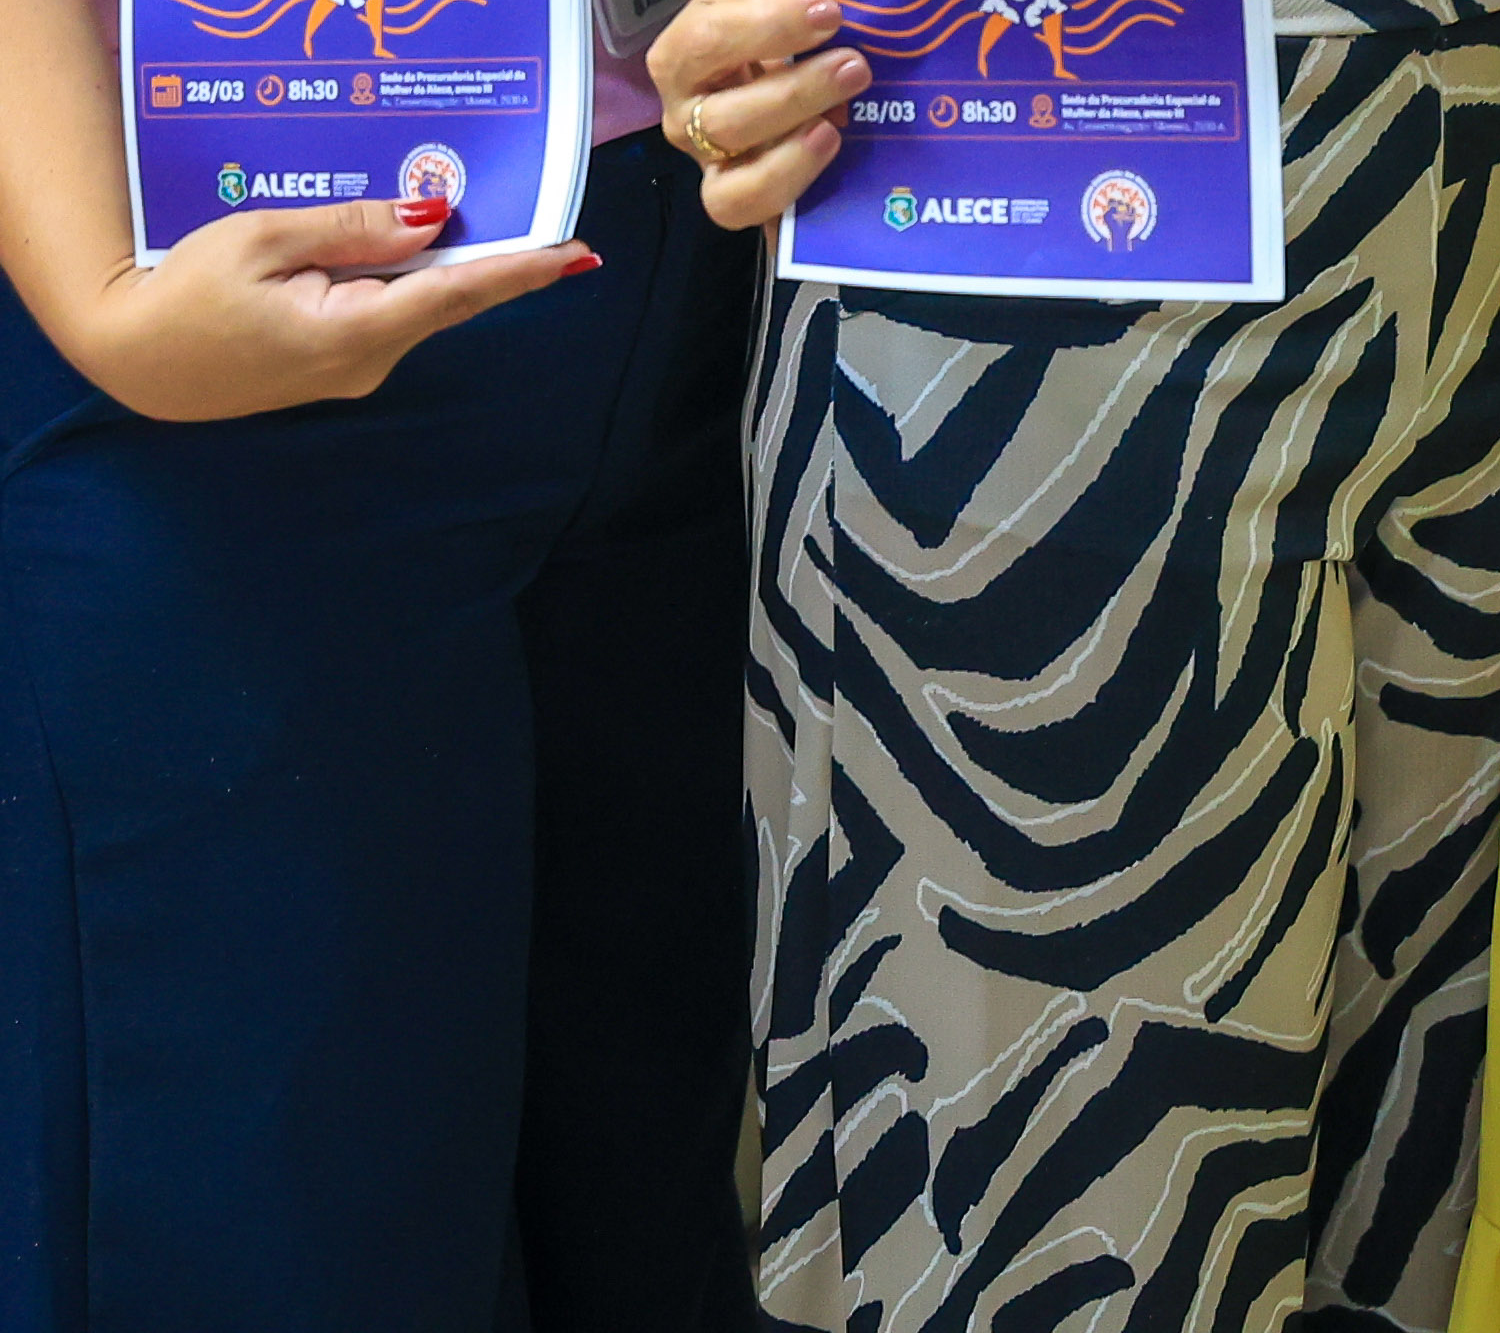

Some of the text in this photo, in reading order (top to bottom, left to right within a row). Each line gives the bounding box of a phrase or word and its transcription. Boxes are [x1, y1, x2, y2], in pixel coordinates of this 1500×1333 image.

[186, 79, 339, 105] 28/03 8h30
[852, 99, 1018, 124] 28/03 8h30
[250, 172, 331, 198] ALECE
[920, 197, 1010, 225] ALECE
